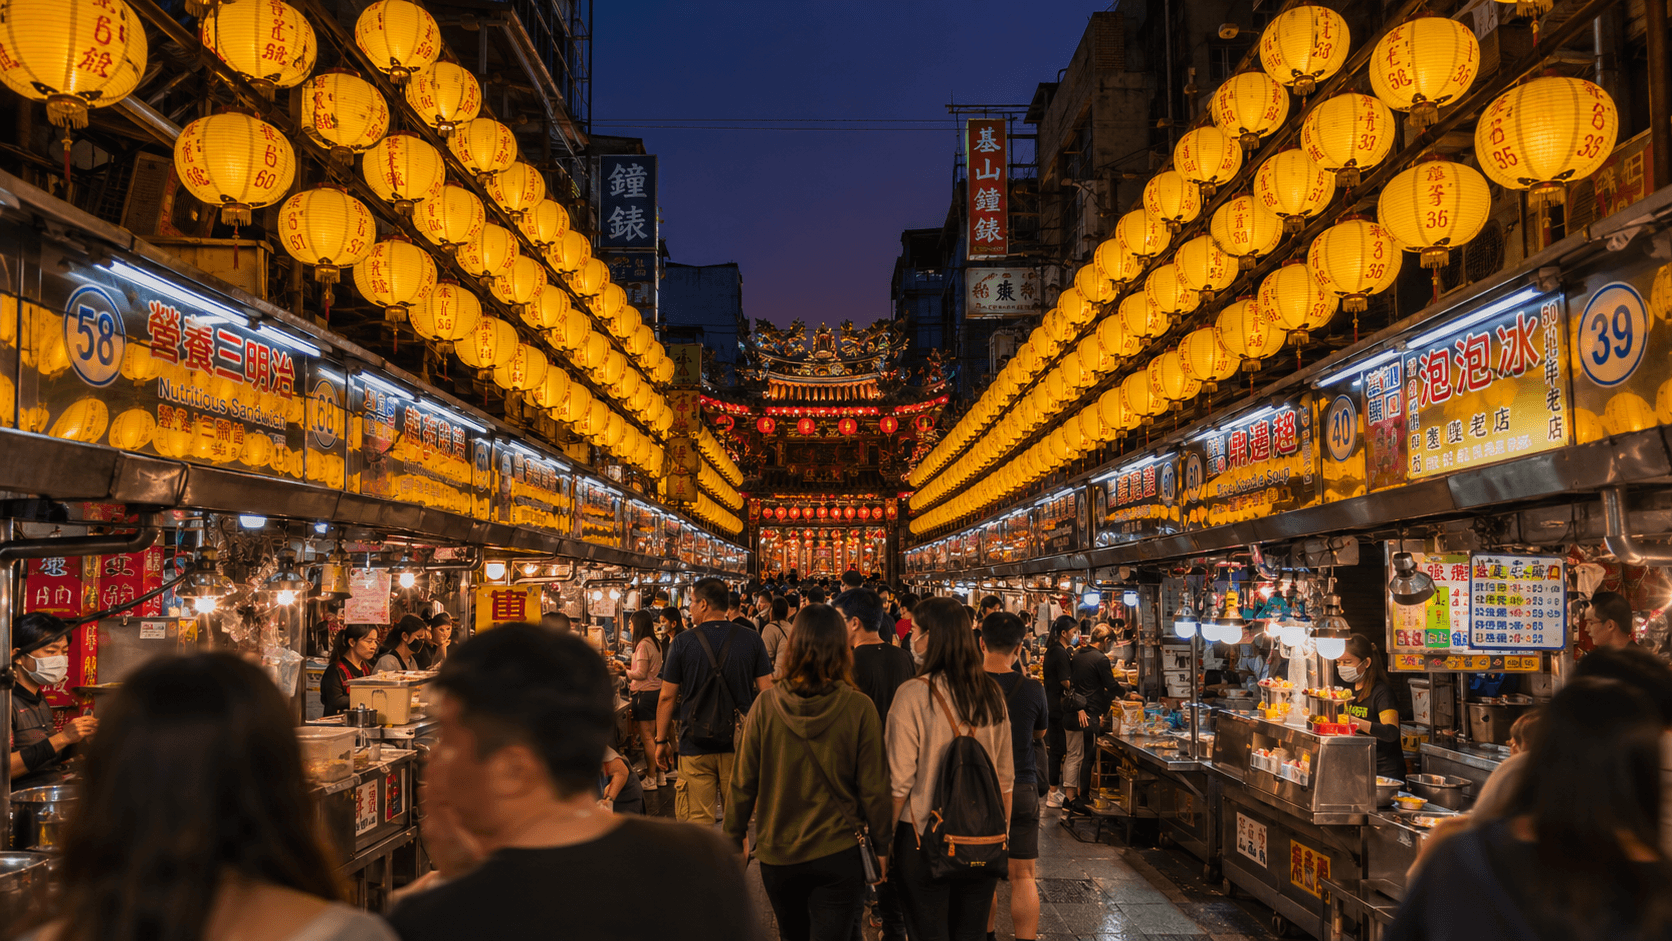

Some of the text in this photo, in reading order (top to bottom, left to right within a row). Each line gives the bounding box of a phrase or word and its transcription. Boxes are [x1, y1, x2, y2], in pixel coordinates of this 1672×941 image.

[607, 162, 649, 242] 鐘錶
[973, 126, 1004, 243] 基山鐘錶
[1426, 208, 1449, 230] 36
[75, 304, 116, 366] 58
[148, 300, 296, 400] 營養三明治
[1419, 311, 1540, 407] 泡泡冰
[1591, 304, 1633, 366] 39
[158, 376, 228, 416] Nutritious
[229, 397, 287, 431] Sandwich
[1331, 410, 1350, 448] 40
